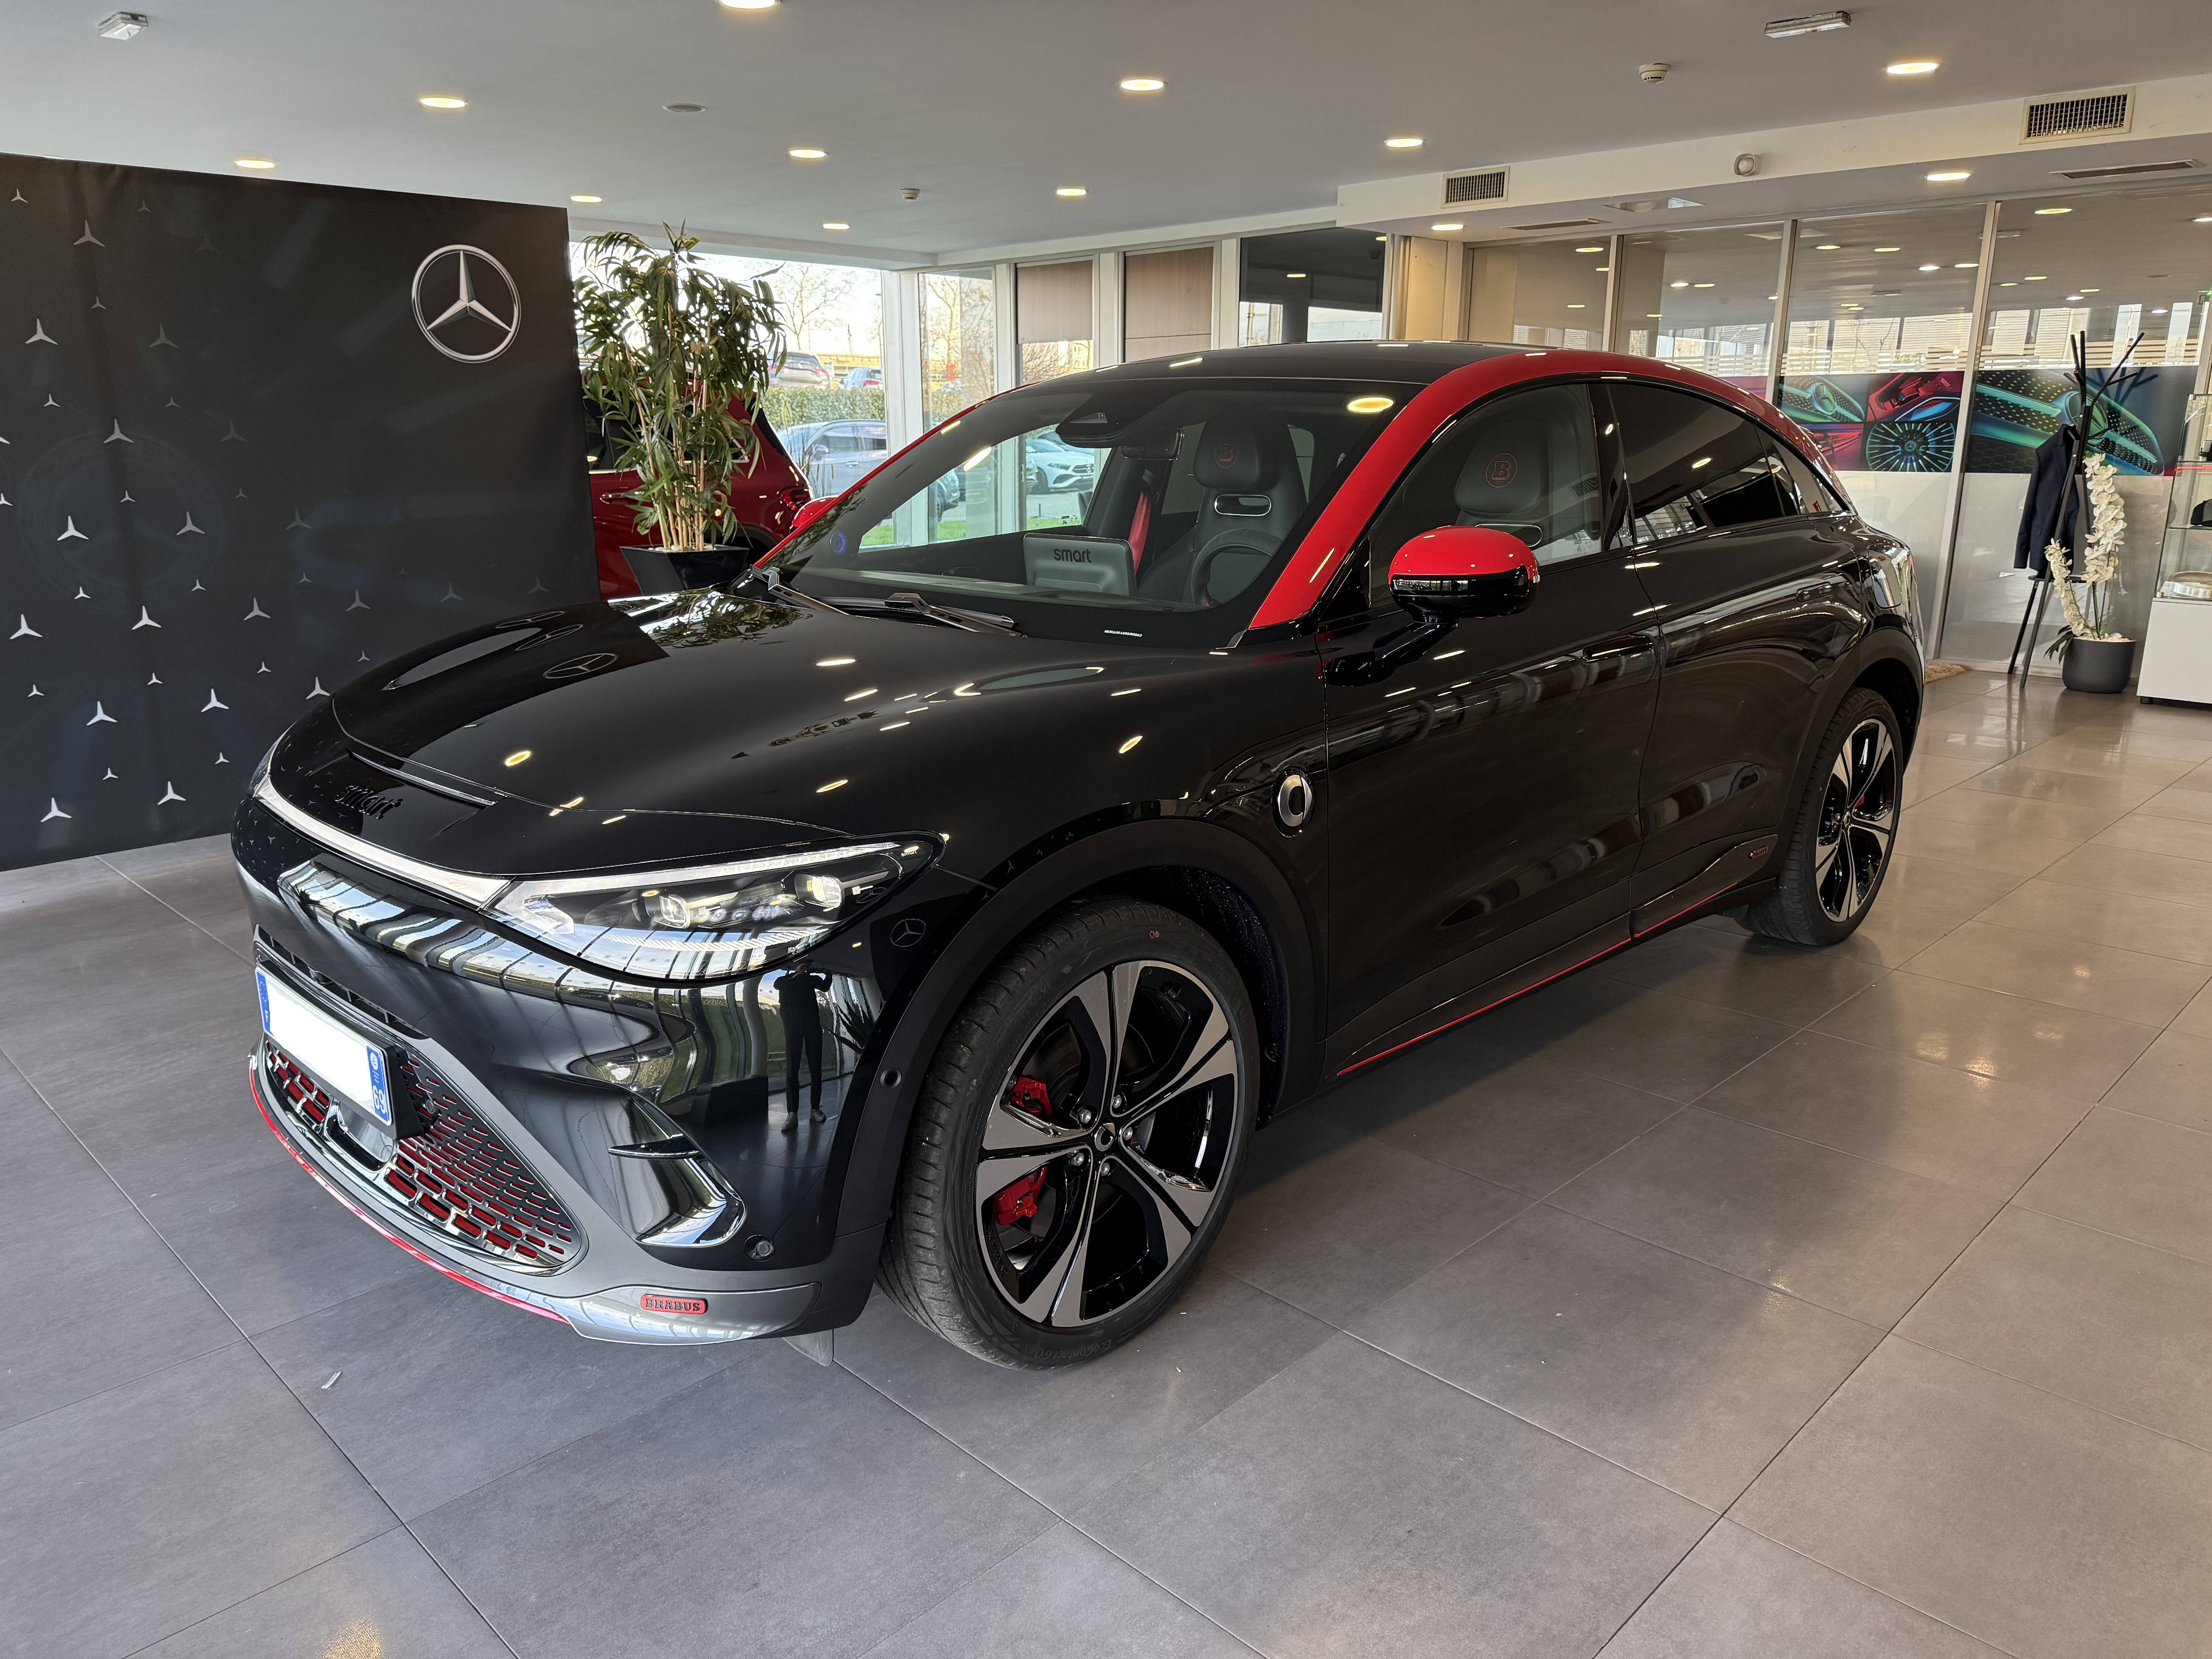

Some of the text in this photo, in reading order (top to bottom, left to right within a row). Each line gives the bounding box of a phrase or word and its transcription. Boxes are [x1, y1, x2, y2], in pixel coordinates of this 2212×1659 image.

[1491, 460, 1512, 481] B
[1053, 548, 1092, 563] smart
[264, 1009, 269, 1023] F
[373, 1085, 386, 1114] 69
[646, 1298, 701, 1312] BRABUS
